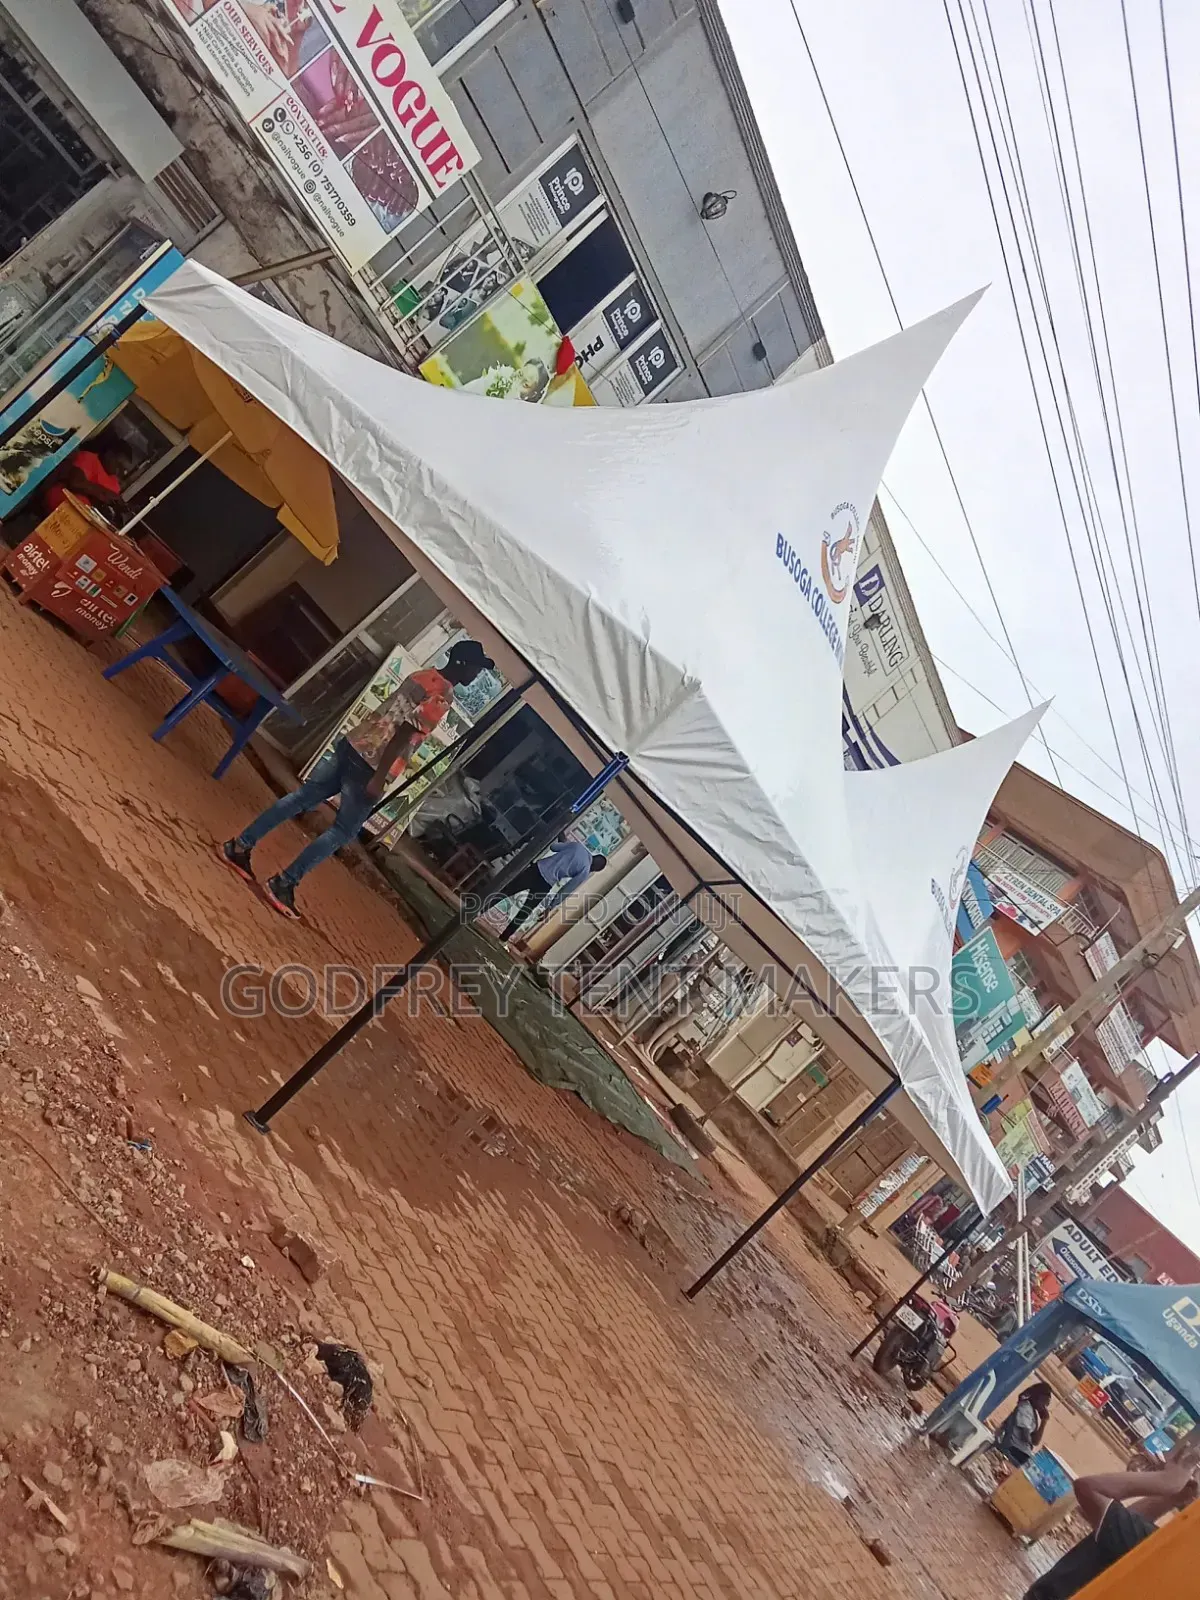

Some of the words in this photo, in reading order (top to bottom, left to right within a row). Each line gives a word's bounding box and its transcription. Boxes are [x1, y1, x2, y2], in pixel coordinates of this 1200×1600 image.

[196, 30, 208, 44] Nail
[205, 44, 229, 77] Extensions
[202, 26, 214, 40] Nail
[211, 40, 223, 54] Care
[222, 1, 242, 27] OUR
[239, 25, 274, 75] SERVICES
[236, 67, 255, 92] Designs
[356, 4, 464, 189] VOGUE
[270, 130, 306, 180] @nailvogue
[311, 191, 345, 238] @nailvogue
[291, 133, 313, 160] +256
[306, 159, 323, 177] (0)
[318, 175, 356, 227] 751710359
[549, 177, 574, 210] Prince
[610, 308, 632, 336] Prince
[635, 355, 655, 381] Prince
[13, 552, 40, 577] money
[20, 540, 53, 571] airtel
[101, 543, 144, 582] Wendi
[776, 532, 812, 601] BUSOGA
[75, 604, 107, 633] money
[868, 594, 904, 668] DARLING
[1024, 886, 1048, 906] DENTAL
[1047, 903, 1062, 916] SPA
[968, 938, 999, 993] Hisense
[1062, 1223, 1103, 1264] ADULT
[1162, 1307, 1198, 1348] Uganda
